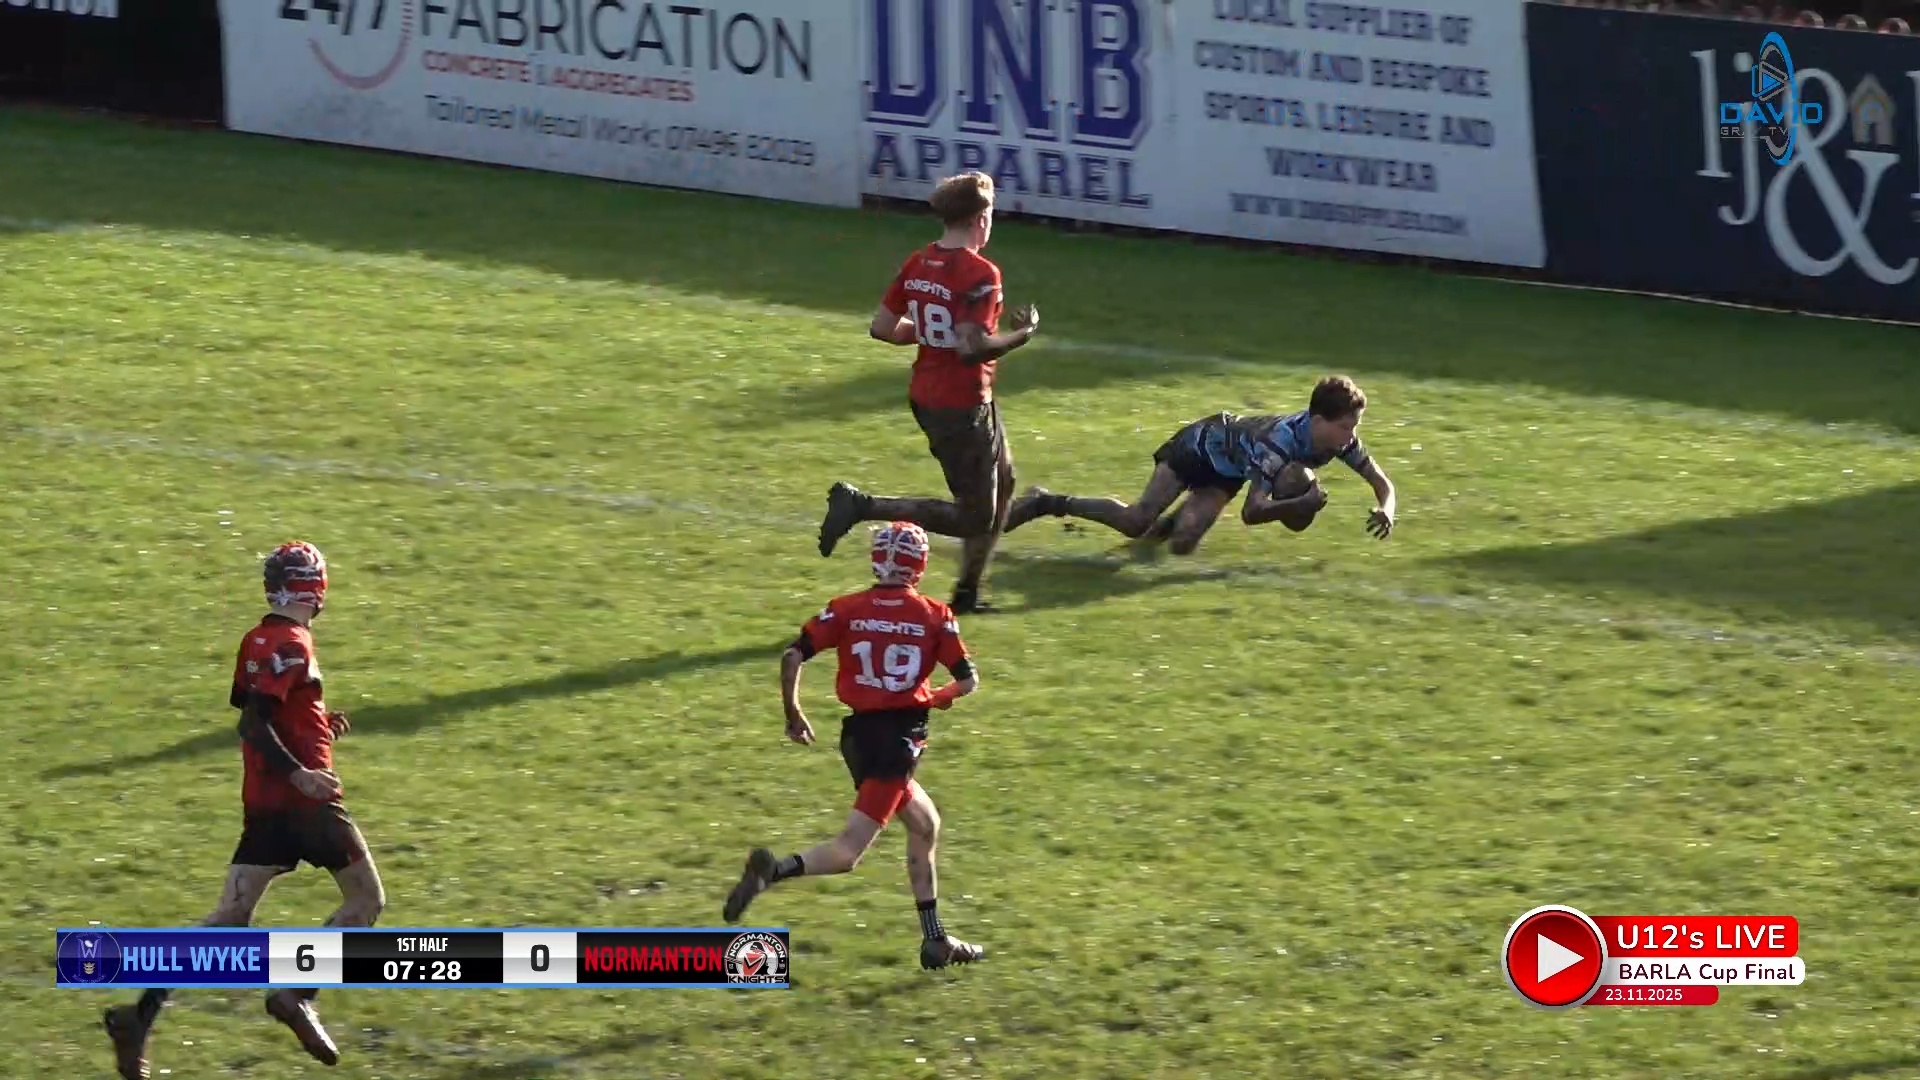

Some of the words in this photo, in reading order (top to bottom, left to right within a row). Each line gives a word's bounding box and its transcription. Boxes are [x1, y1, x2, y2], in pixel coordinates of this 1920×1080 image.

[421, 0, 812, 82] FABRICATION
[1304, 1, 1435, 42] SUPPLIER
[1439, 14, 1474, 46] OF
[423, 50, 531, 83] CONCRETE
[1194, 40, 1301, 78] CUSTOM
[1307, 52, 1365, 85] AND
[1369, 57, 1493, 98] BESPOKE
[424, 94, 514, 130] Tailored
[519, 106, 589, 140] Metal
[1316, 101, 1434, 143] LEISURE
[1440, 114, 1495, 148] AND
[868, 130, 1153, 210] APPAREL
[1264, 146, 1438, 193] WORKWEAR
[903, 278, 952, 301] KNIGHTS
[907, 299, 960, 348] 18
[849, 618, 926, 637] KNIGHTS
[851, 640, 922, 692] 19
